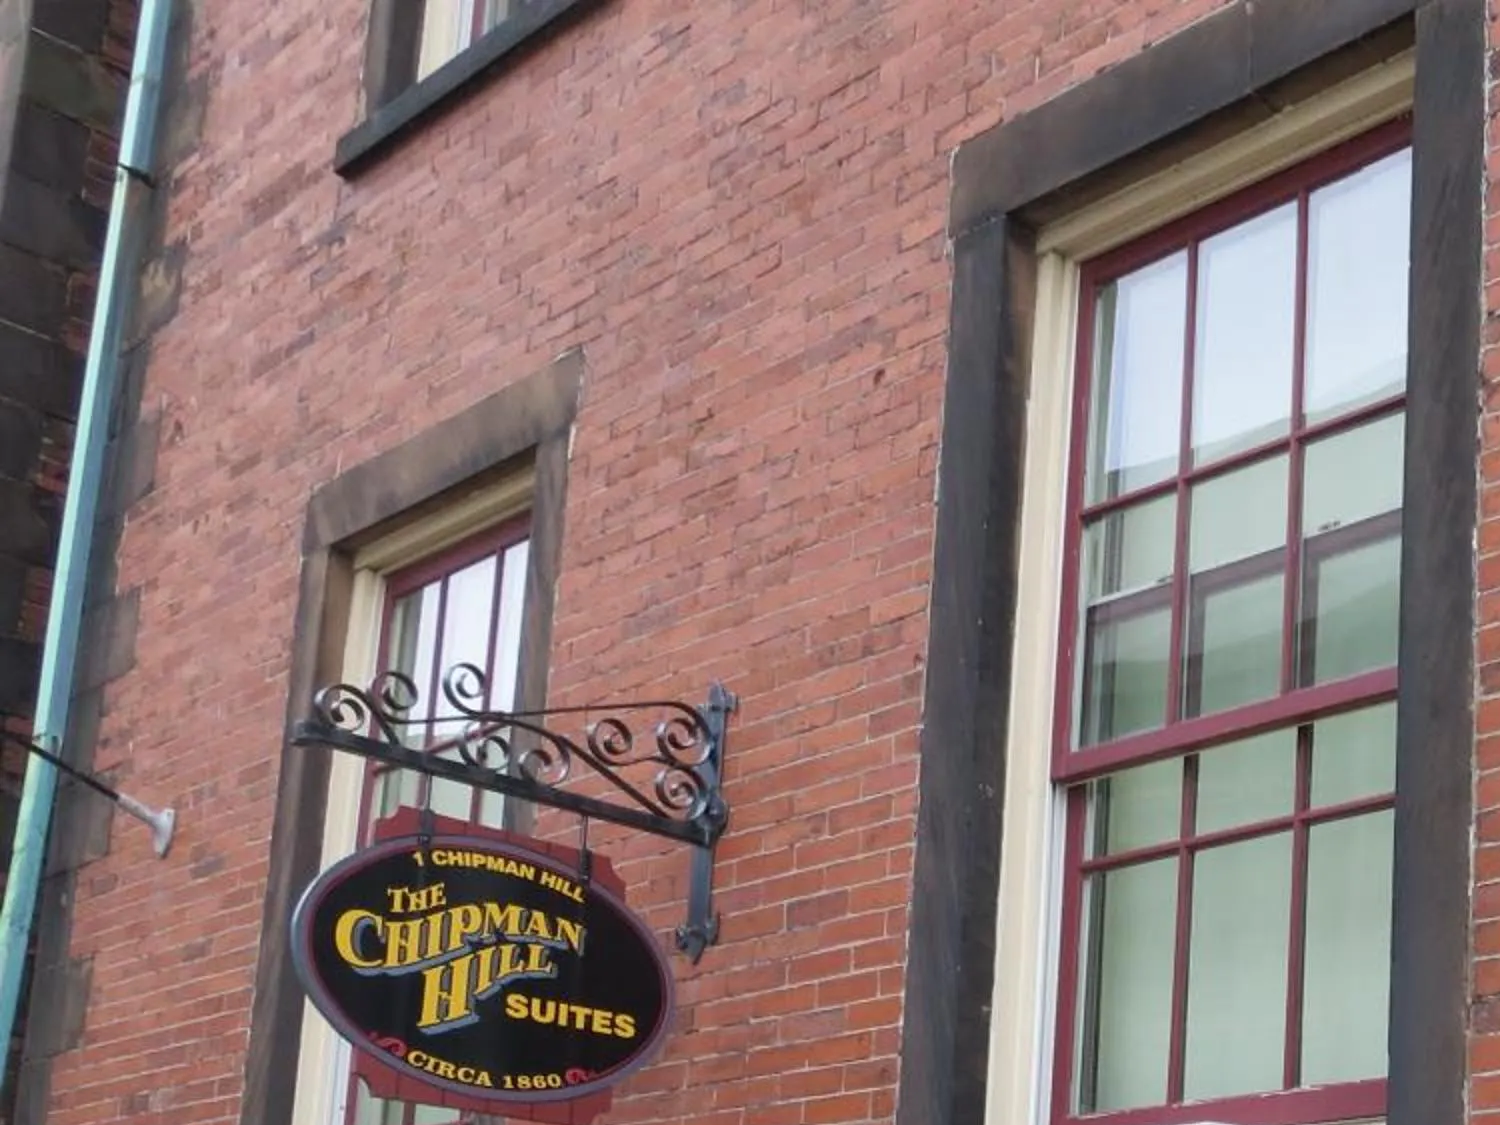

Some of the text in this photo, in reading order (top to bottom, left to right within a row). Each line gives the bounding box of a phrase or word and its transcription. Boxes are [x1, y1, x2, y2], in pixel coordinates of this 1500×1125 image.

[387, 882, 447, 914] THE
[412, 850, 586, 904] 1 CHIPMAN HILL
[335, 901, 585, 971] CHIPMAN
[417, 943, 554, 1029] HILL
[505, 993, 637, 1039] SUITES
[407, 1050, 563, 1090] CIRCA 1860
